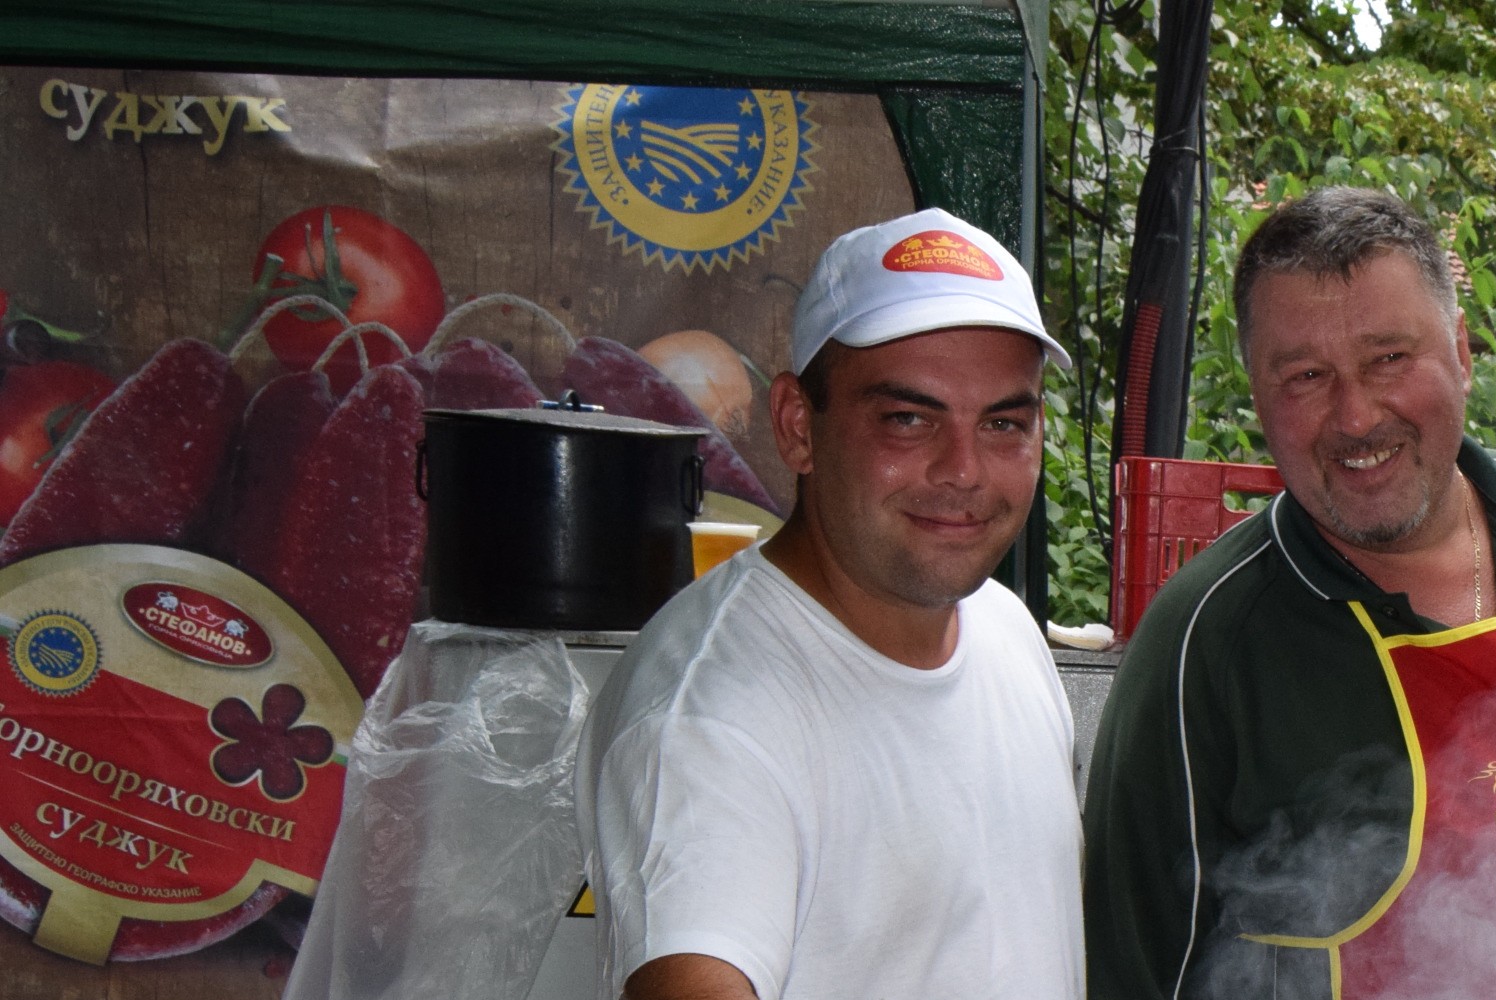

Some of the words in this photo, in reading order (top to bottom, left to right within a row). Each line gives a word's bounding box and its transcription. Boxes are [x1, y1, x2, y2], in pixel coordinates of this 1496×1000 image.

[39, 78, 292, 156] суджук
[586, 85, 627, 202] ЗАЩИТЕН
[901, 247, 991, 272] СТЕФАНОВ
[145, 606, 246, 655] СТЕФАНОВ
[0, 703, 297, 842] орнооряховски
[9, 822, 67, 868] ЗАЩИТЕНО
[67, 862, 139, 895] ГЕОГРАФСКО
[141, 886, 202, 898] УКАЗАНИЕ
[35, 802, 194, 875] суджук
